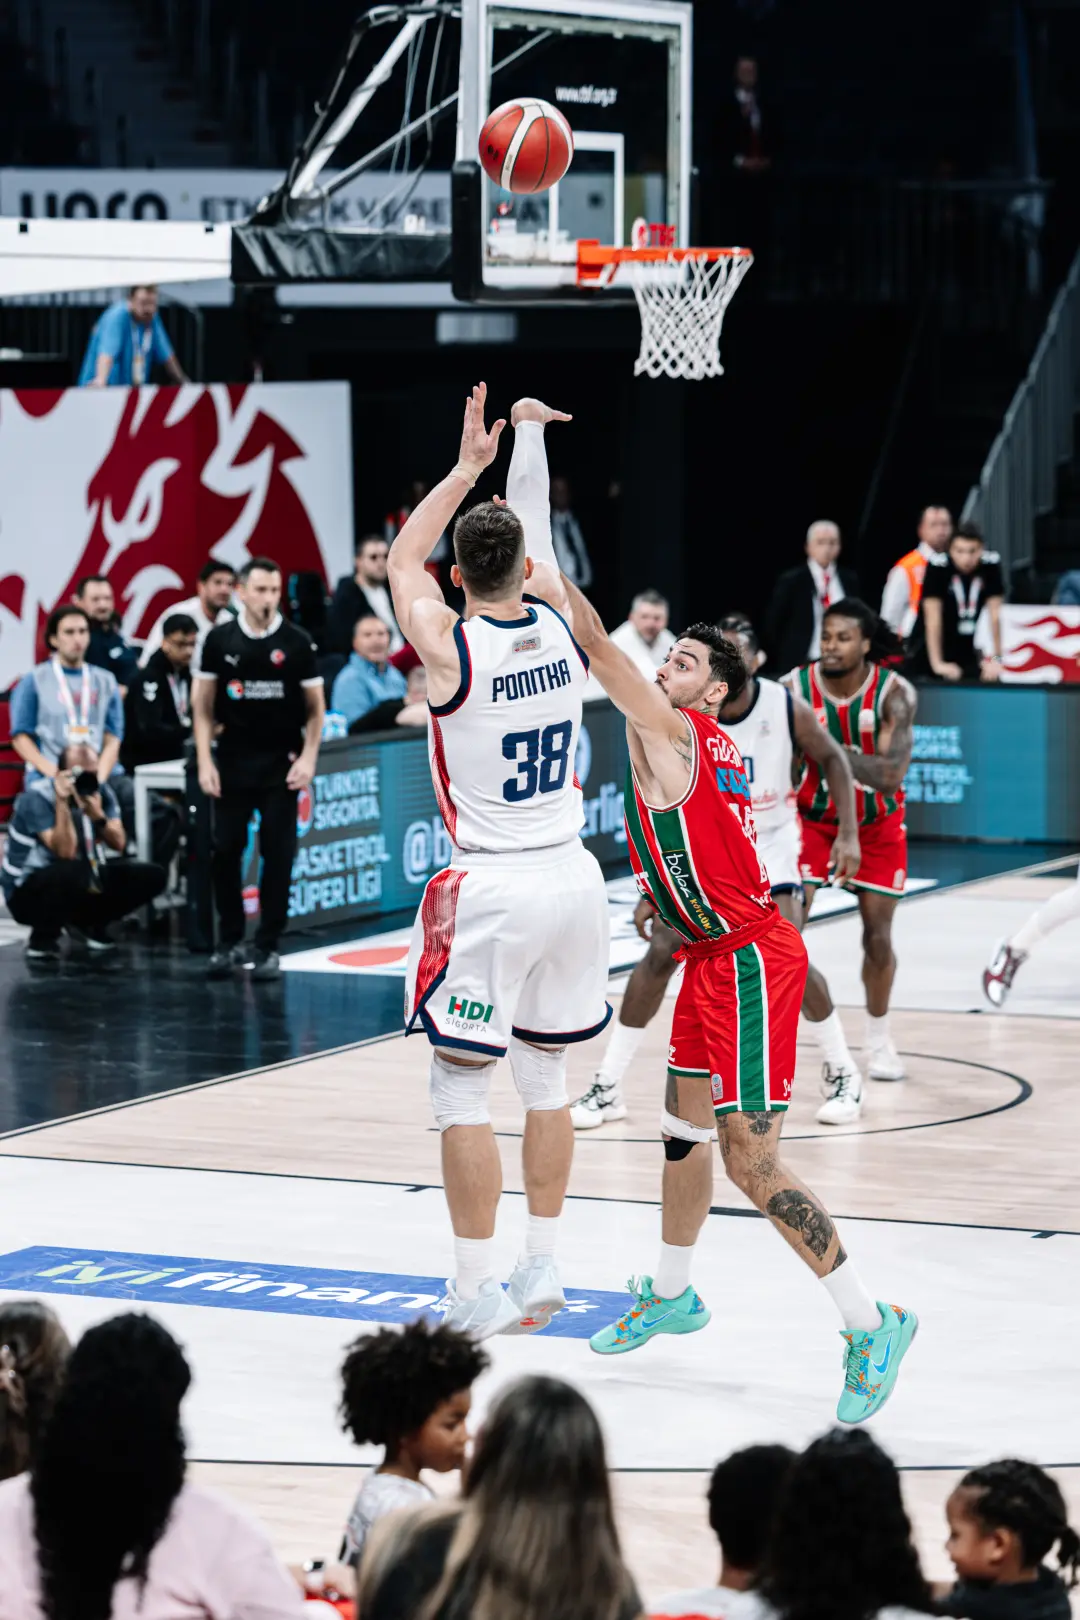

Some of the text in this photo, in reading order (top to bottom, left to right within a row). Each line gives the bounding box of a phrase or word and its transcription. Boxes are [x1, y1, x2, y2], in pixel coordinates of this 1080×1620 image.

[492, 658, 571, 702] PONITKA
[501, 719, 573, 802] 38
[291, 833, 391, 880] ASKETBOL
[447, 995, 494, 1024] HDI
[33, 1260, 186, 1285] iyi
